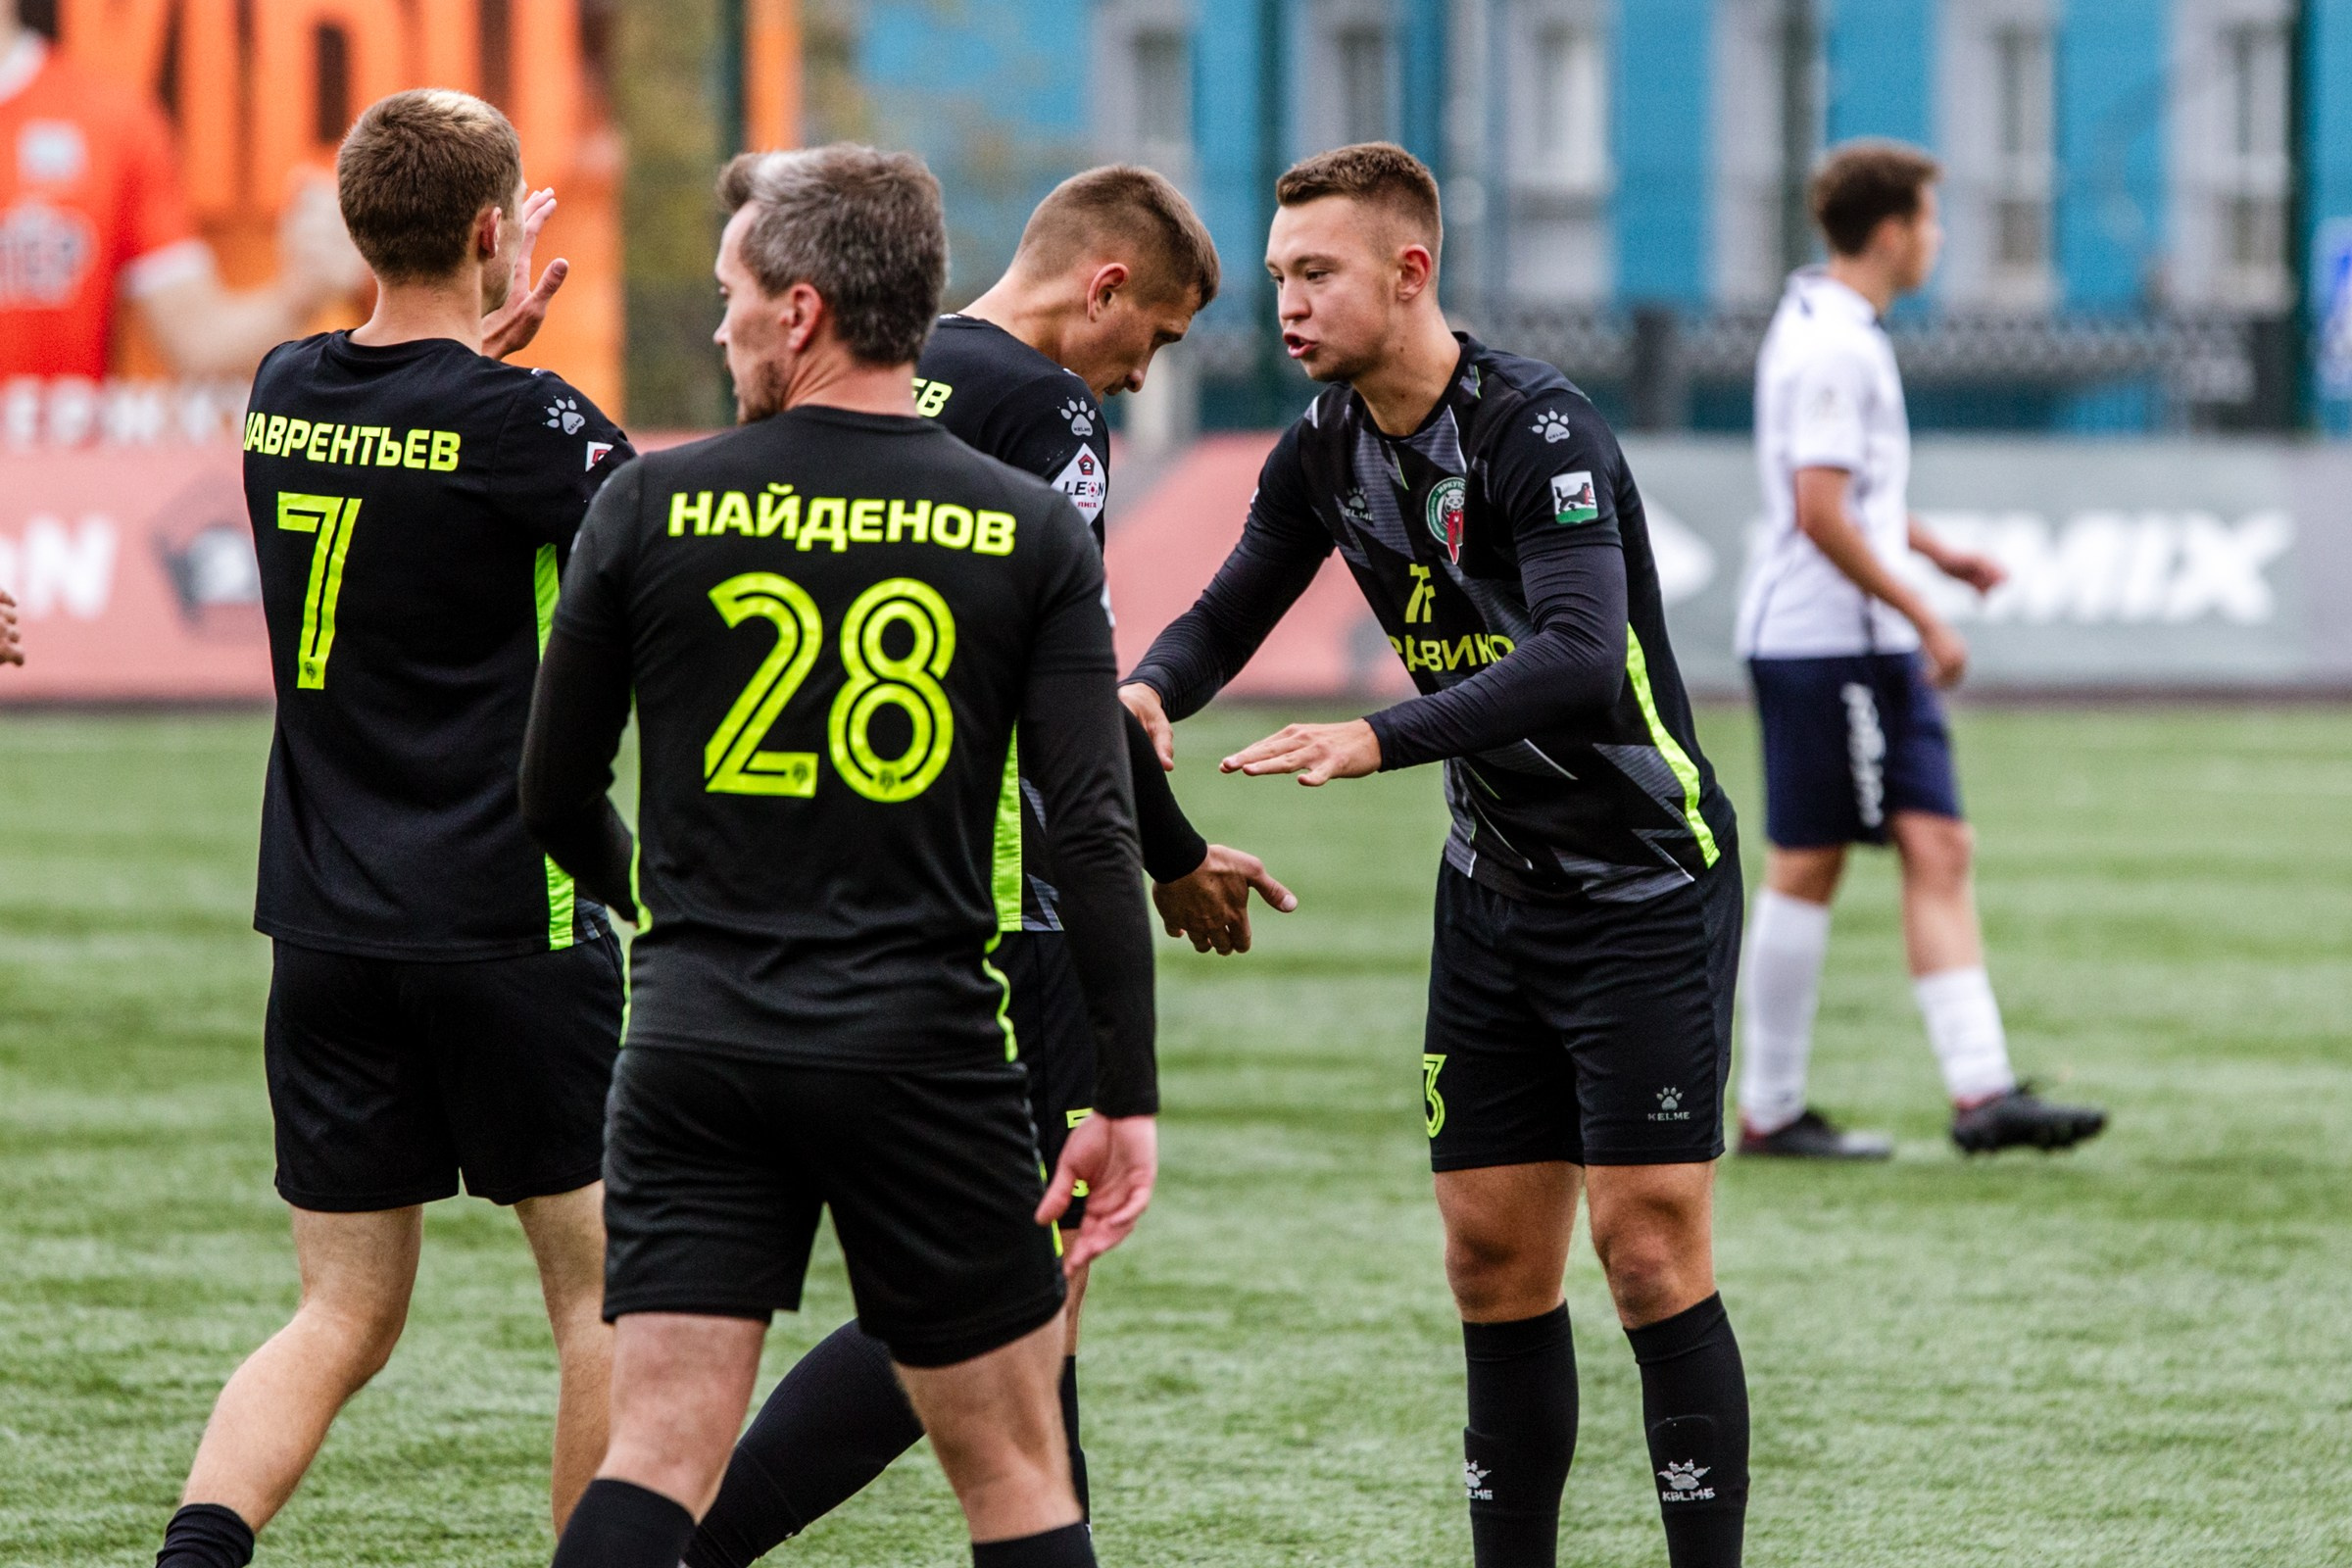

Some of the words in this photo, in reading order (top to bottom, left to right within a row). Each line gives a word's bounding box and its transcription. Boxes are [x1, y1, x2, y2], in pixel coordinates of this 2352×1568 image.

[668, 482, 1016, 556] НАЙДЕНОВ
[277, 491, 363, 690] 7
[705, 571, 956, 802] 28
[1647, 1111, 1690, 1121] KELME
